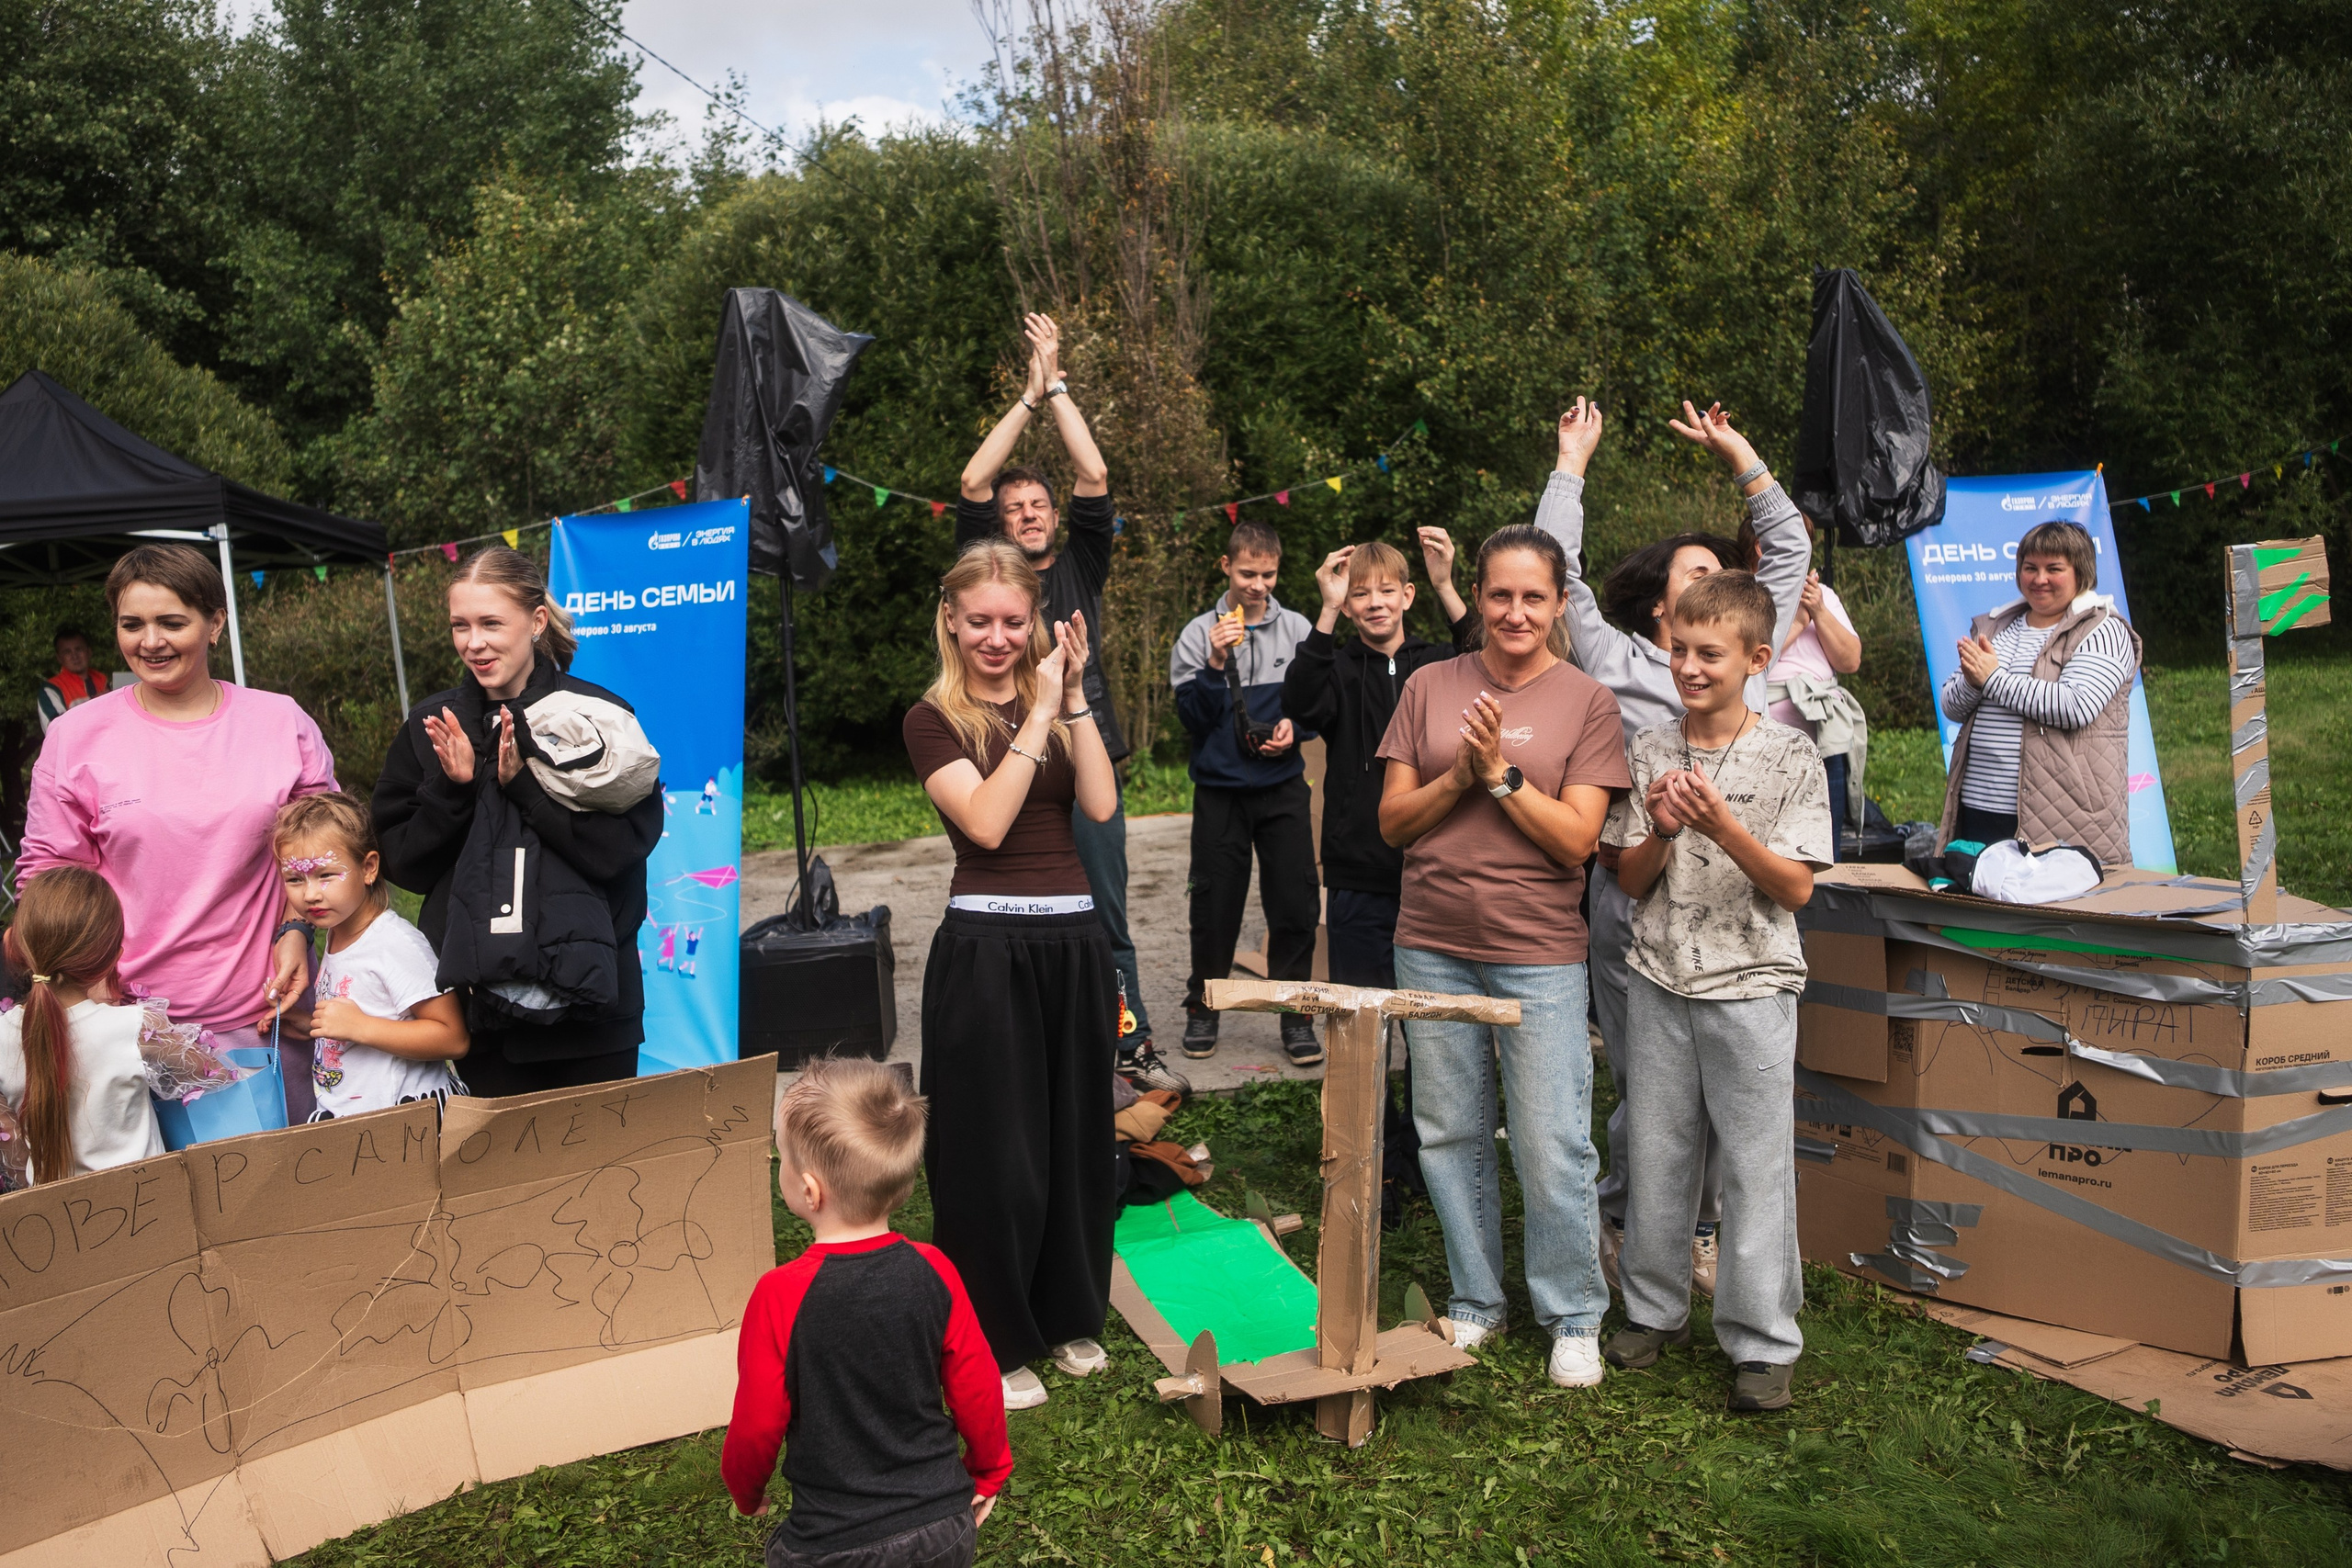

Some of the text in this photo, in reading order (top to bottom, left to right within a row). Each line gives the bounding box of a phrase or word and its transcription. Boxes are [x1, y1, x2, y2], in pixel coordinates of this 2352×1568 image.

[695, 526, 735, 538] ЭНЕРГИЯ
[699, 536, 731, 546] ЛЮДЯХ
[1922, 543, 1996, 566] ДЕНЬ
[1925, 571, 2016, 584] Кемерово 30 август
[564, 580, 735, 616] ДЕНЬ СЕМЬИ
[570, 623, 657, 637] мерово 30 августа
[1724, 793, 1756, 803] NIKE
[988, 901, 1054, 914] Calvin Klein
[1691, 946, 1704, 972] NIKE
[2006, 976, 2044, 987] ДЕТСКАЯ
[1301, 986, 1330, 994] КУХНЯ
[1300, 1004, 1347, 1014] ГОСТИНАЯ
[1408, 1010, 1442, 1019] БАЛКОН
[2081, 1002, 2214, 1043] ПИРАТ
[2256, 1050, 2330, 1066] КОРОБ СРЕДНИЙ
[295, 1094, 650, 1185] САМОЛЁТ
[2049, 1144, 2101, 1167] ПРО
[2038, 1168, 2112, 1189] lemanapro.ru
